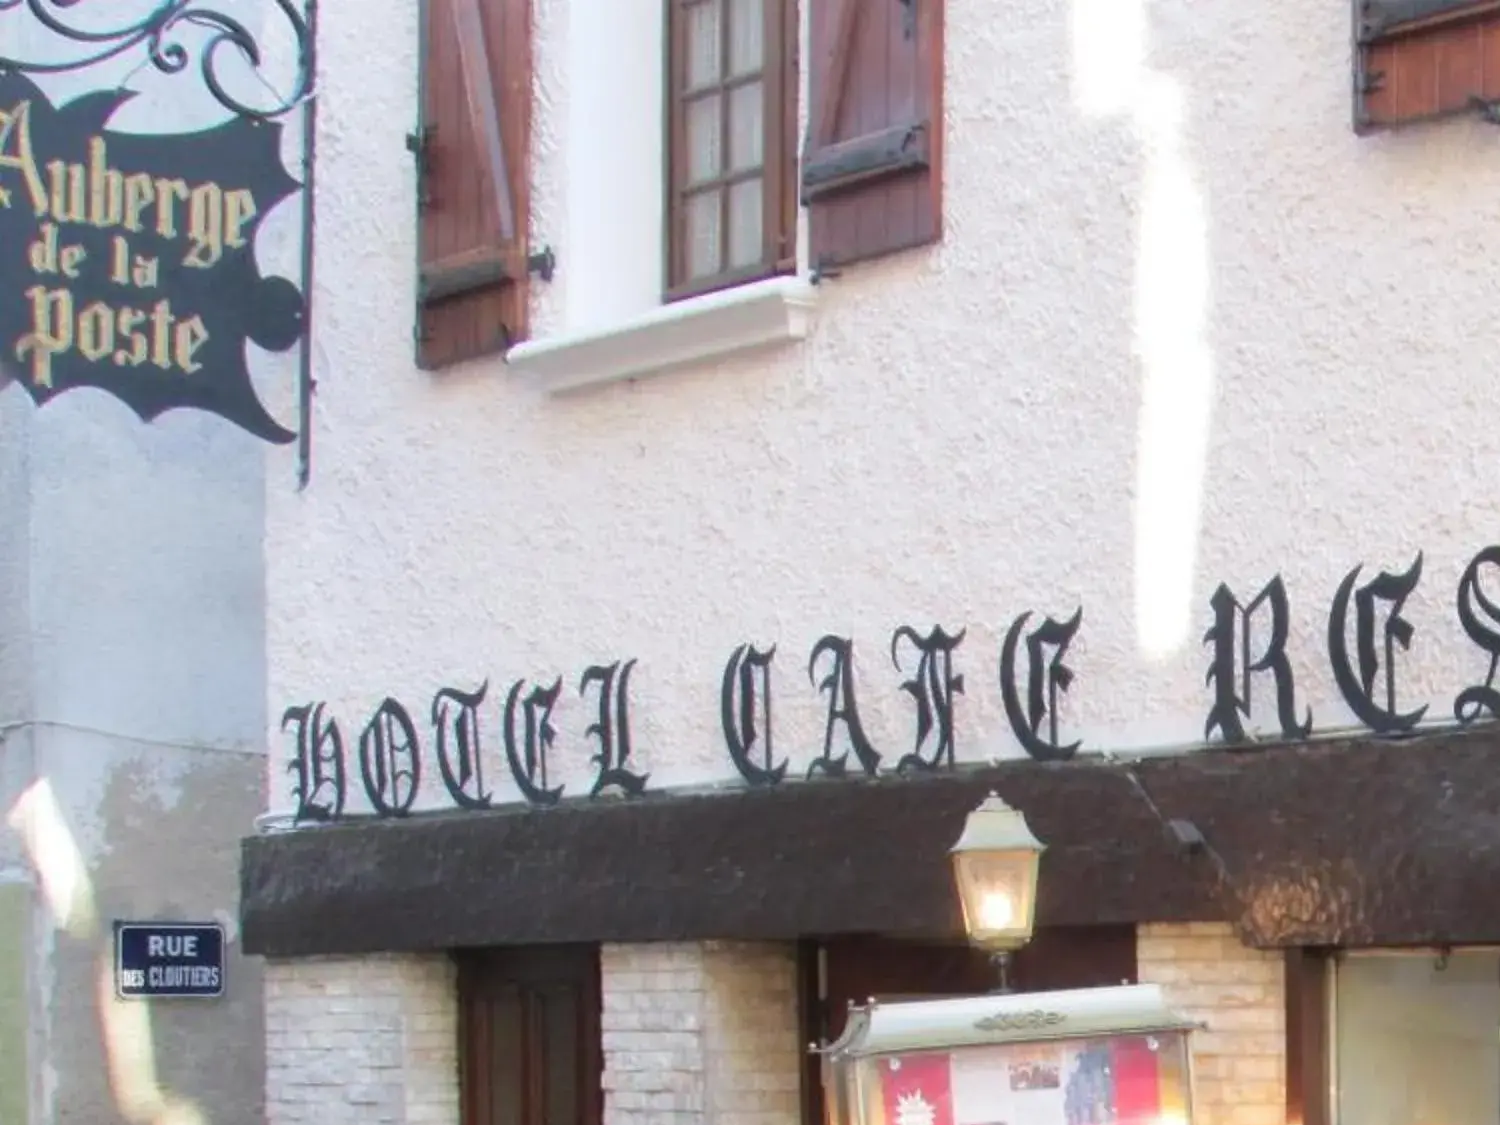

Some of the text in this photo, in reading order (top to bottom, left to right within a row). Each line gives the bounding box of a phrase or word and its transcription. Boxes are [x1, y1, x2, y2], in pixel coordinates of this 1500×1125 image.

[0, 100, 256, 267] Auberge
[29, 223, 159, 288] de la
[17, 285, 209, 388] Poste
[281, 658, 650, 828] HOTEL
[720, 604, 1084, 786] CAFE
[123, 965, 219, 987] DES CLOUTIERS
[148, 935, 198, 957] RUE
